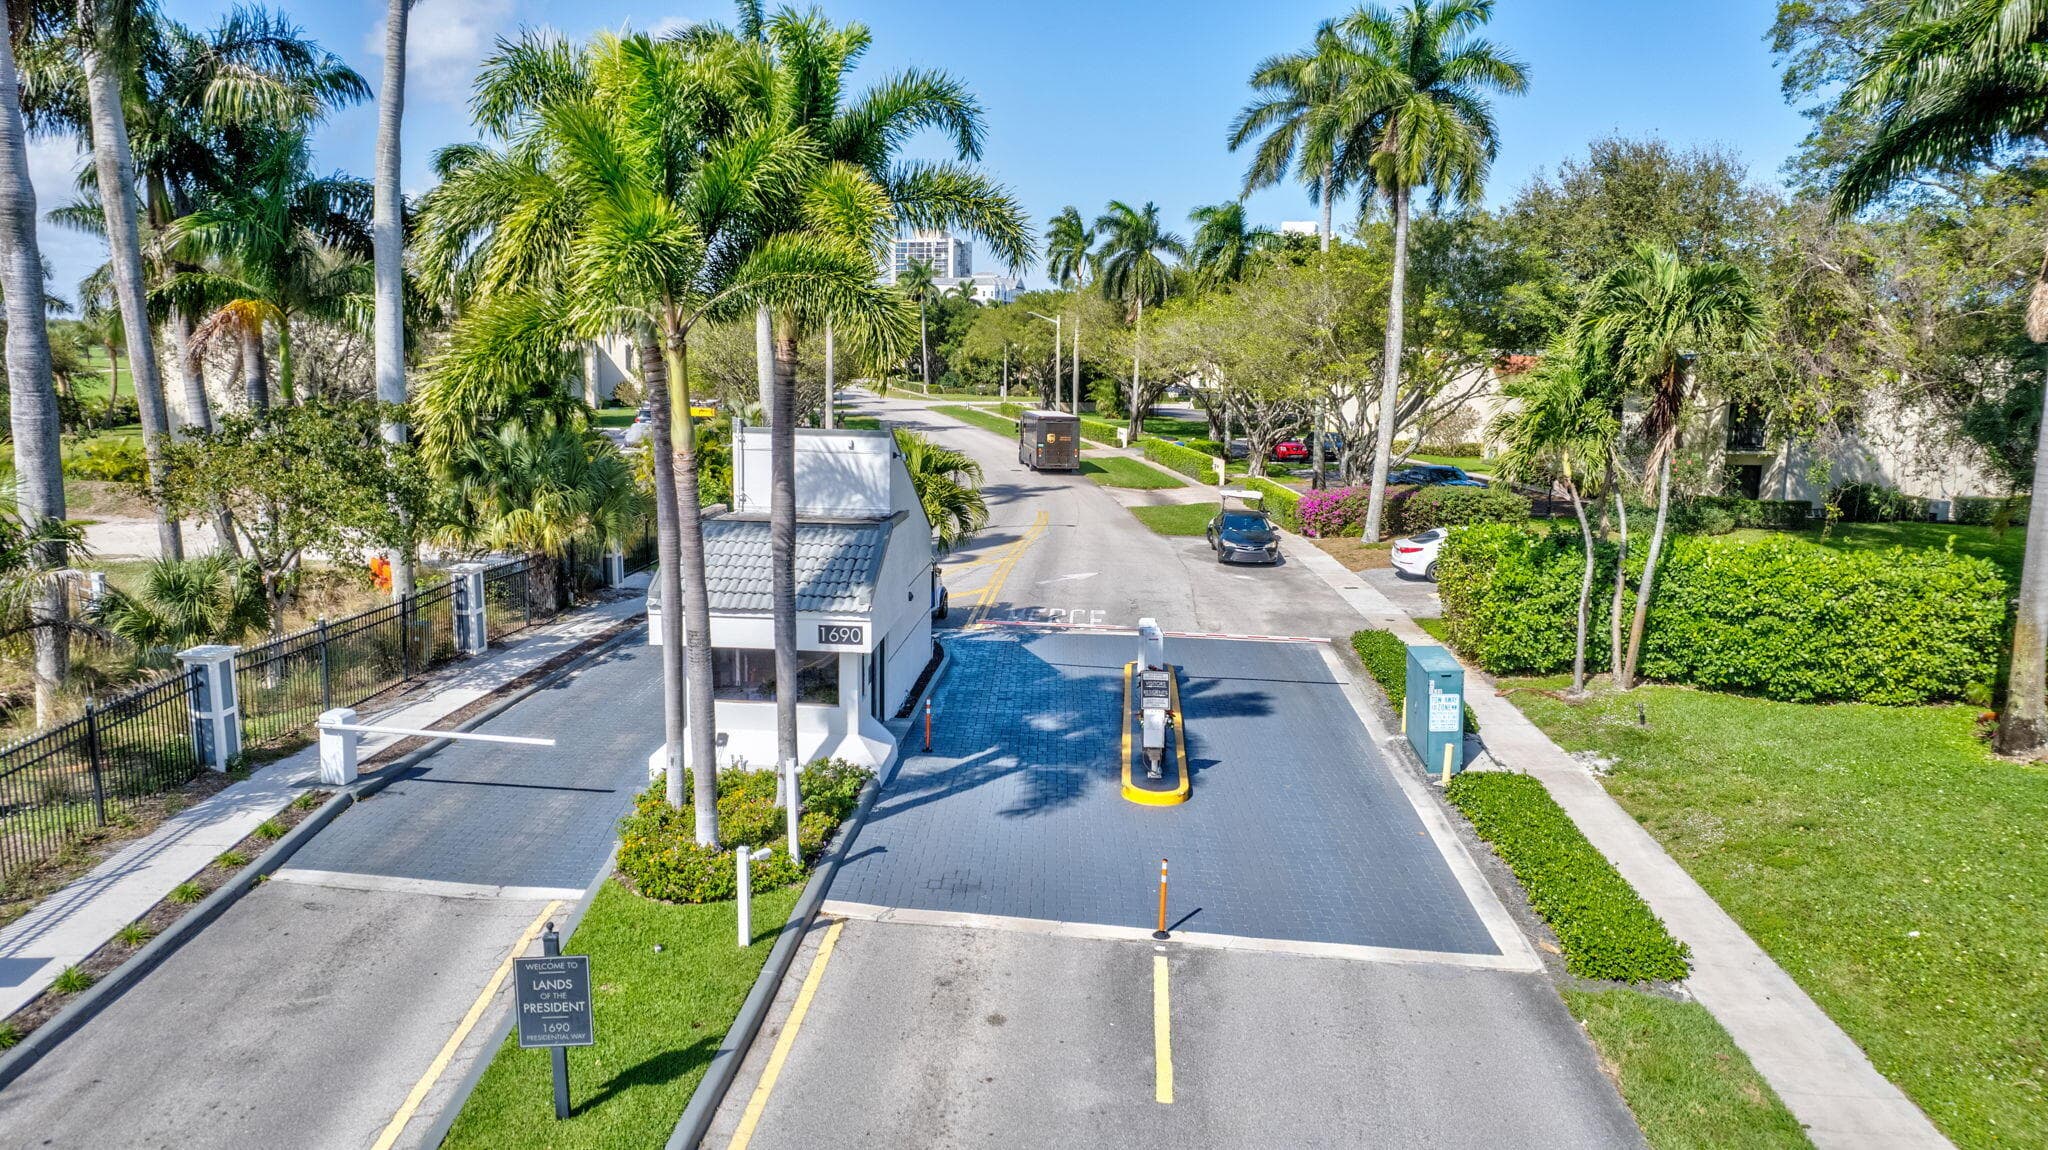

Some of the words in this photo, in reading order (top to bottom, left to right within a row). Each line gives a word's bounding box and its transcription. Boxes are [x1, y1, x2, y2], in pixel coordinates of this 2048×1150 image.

[820, 627, 861, 643] 1690
[525, 962, 565, 970] WELCOME
[533, 979, 573, 990] LANDS
[523, 1001, 585, 1013] PRESIDENT
[543, 1023, 570, 1033] 1690
